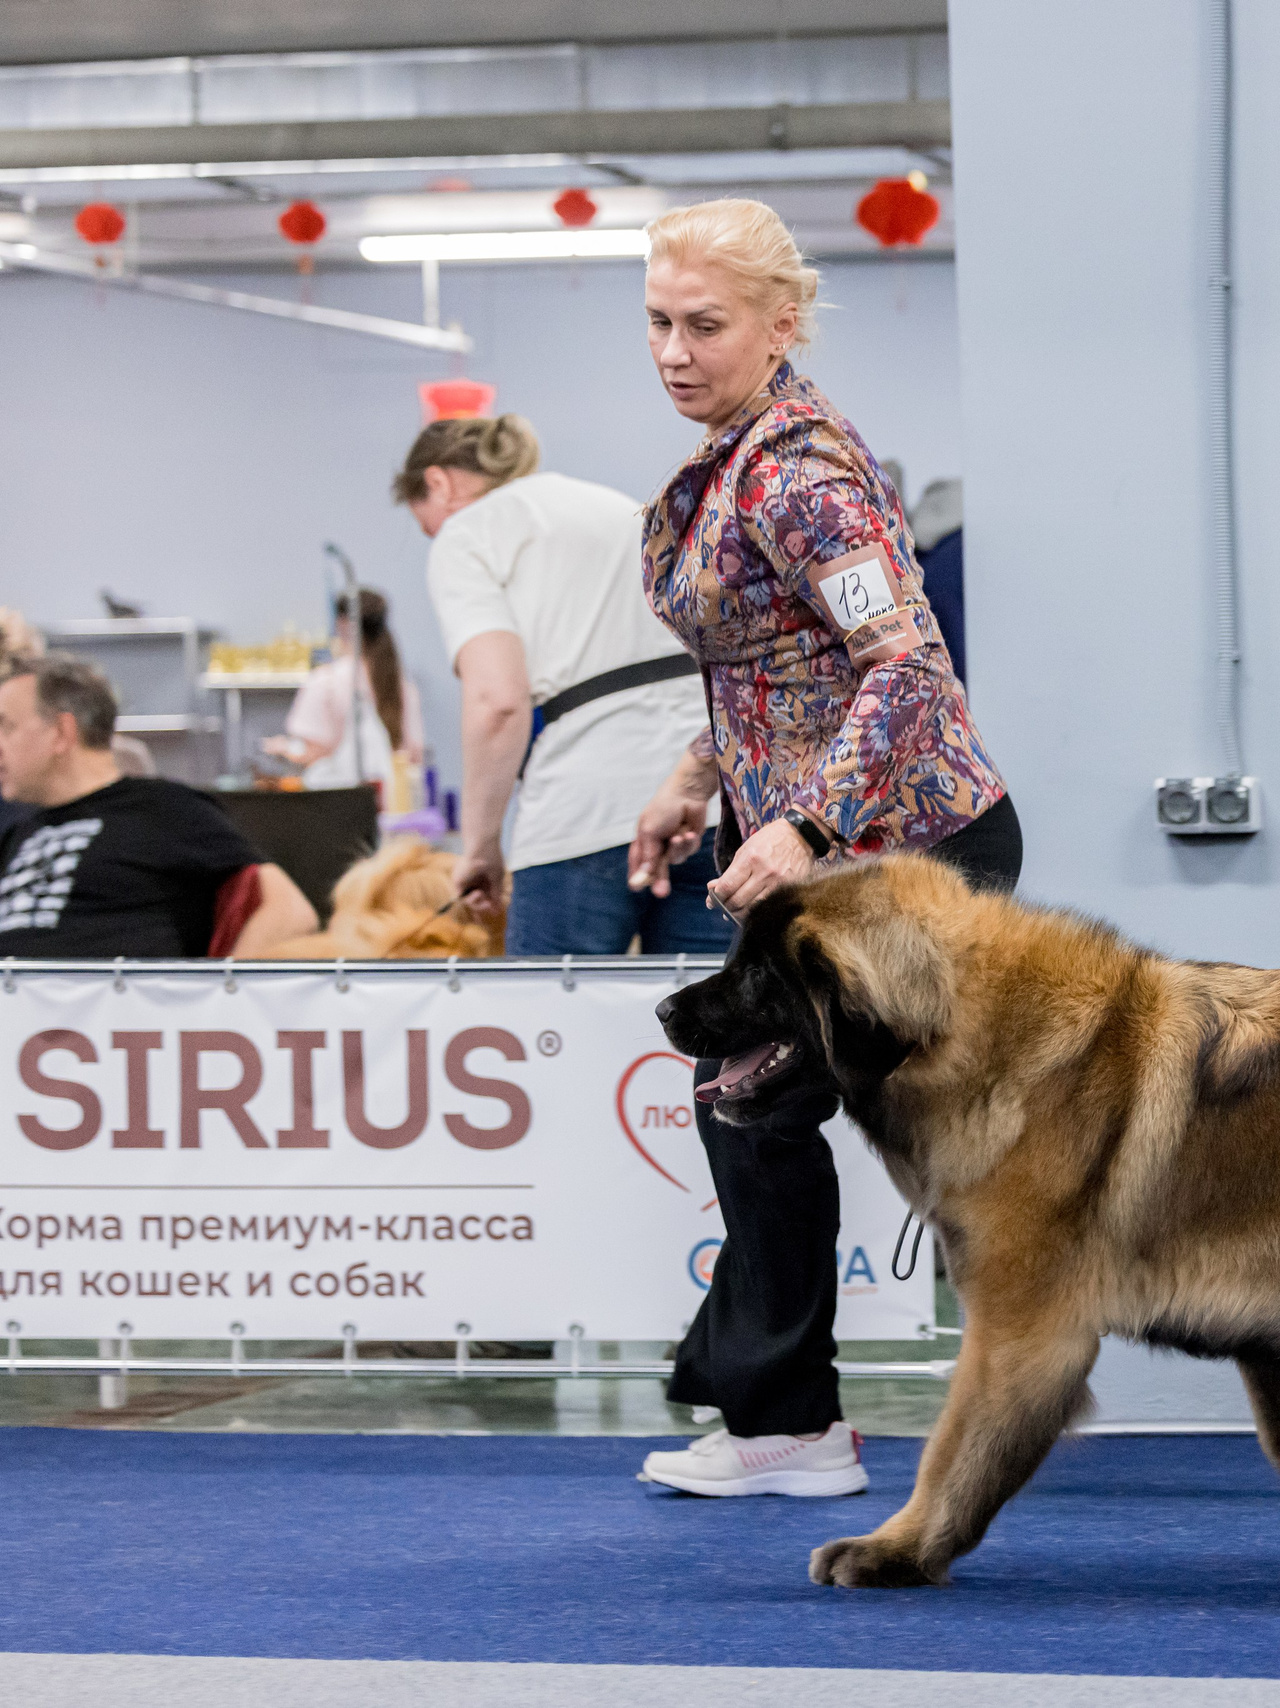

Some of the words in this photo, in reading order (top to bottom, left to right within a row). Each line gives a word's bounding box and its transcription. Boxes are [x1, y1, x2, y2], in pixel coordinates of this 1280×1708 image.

[839, 572, 869, 620] 13
[141, 1212, 534, 1249] премиум-класса
[80, 1270, 231, 1297] кошек
[247, 1270, 273, 1297] и
[290, 1262, 426, 1297] собак
